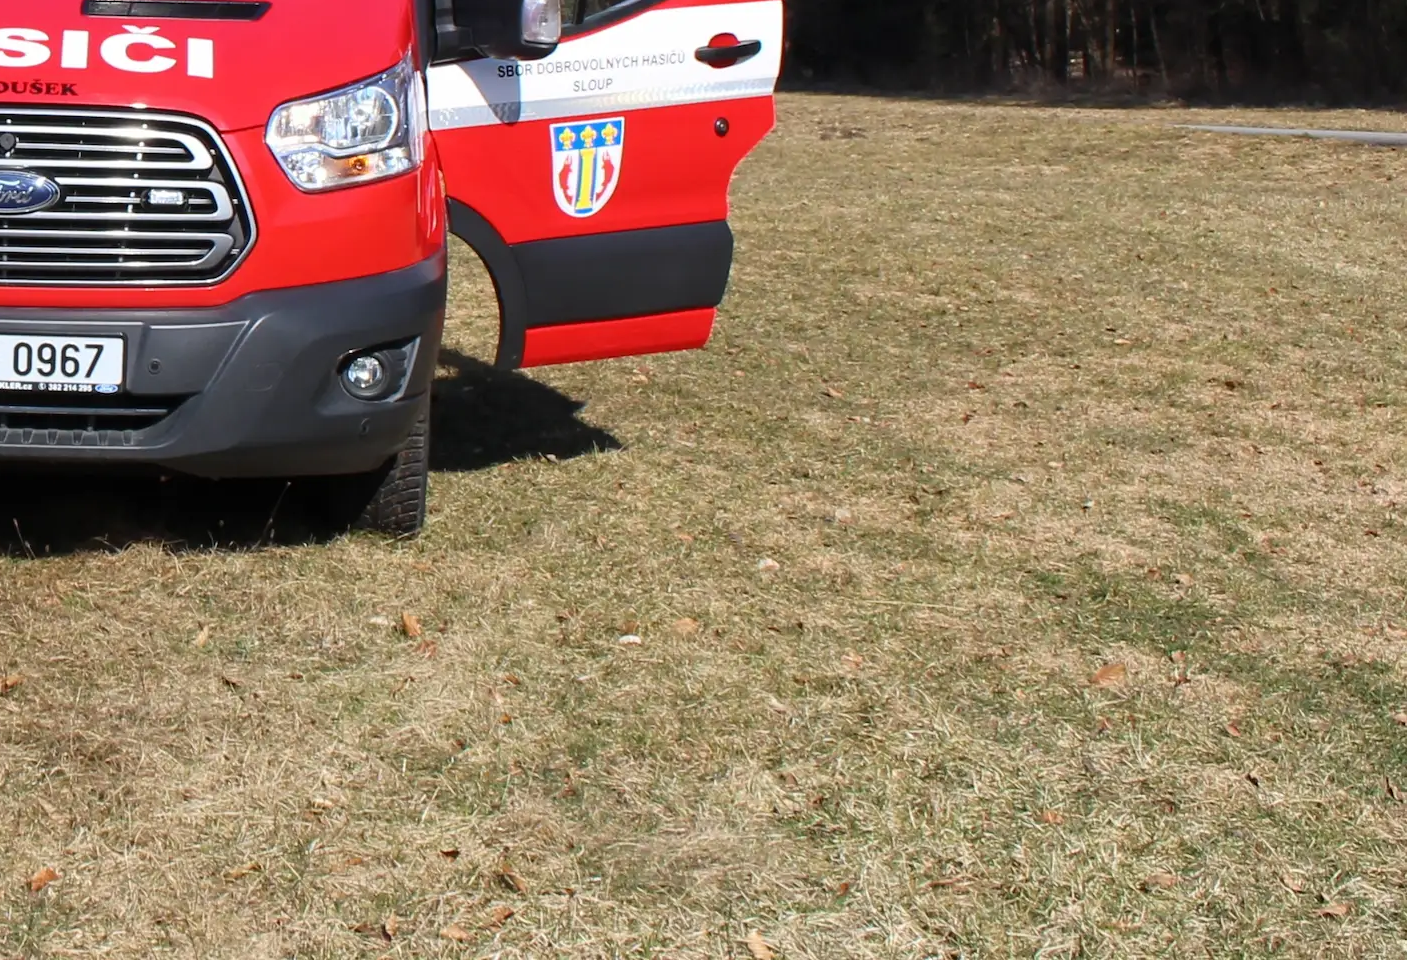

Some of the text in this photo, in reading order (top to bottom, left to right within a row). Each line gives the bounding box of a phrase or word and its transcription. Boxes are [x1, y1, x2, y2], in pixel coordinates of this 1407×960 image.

[497, 62, 533, 78] SBOR
[573, 77, 613, 93] SLOUP
[12, 341, 105, 379] 0967
